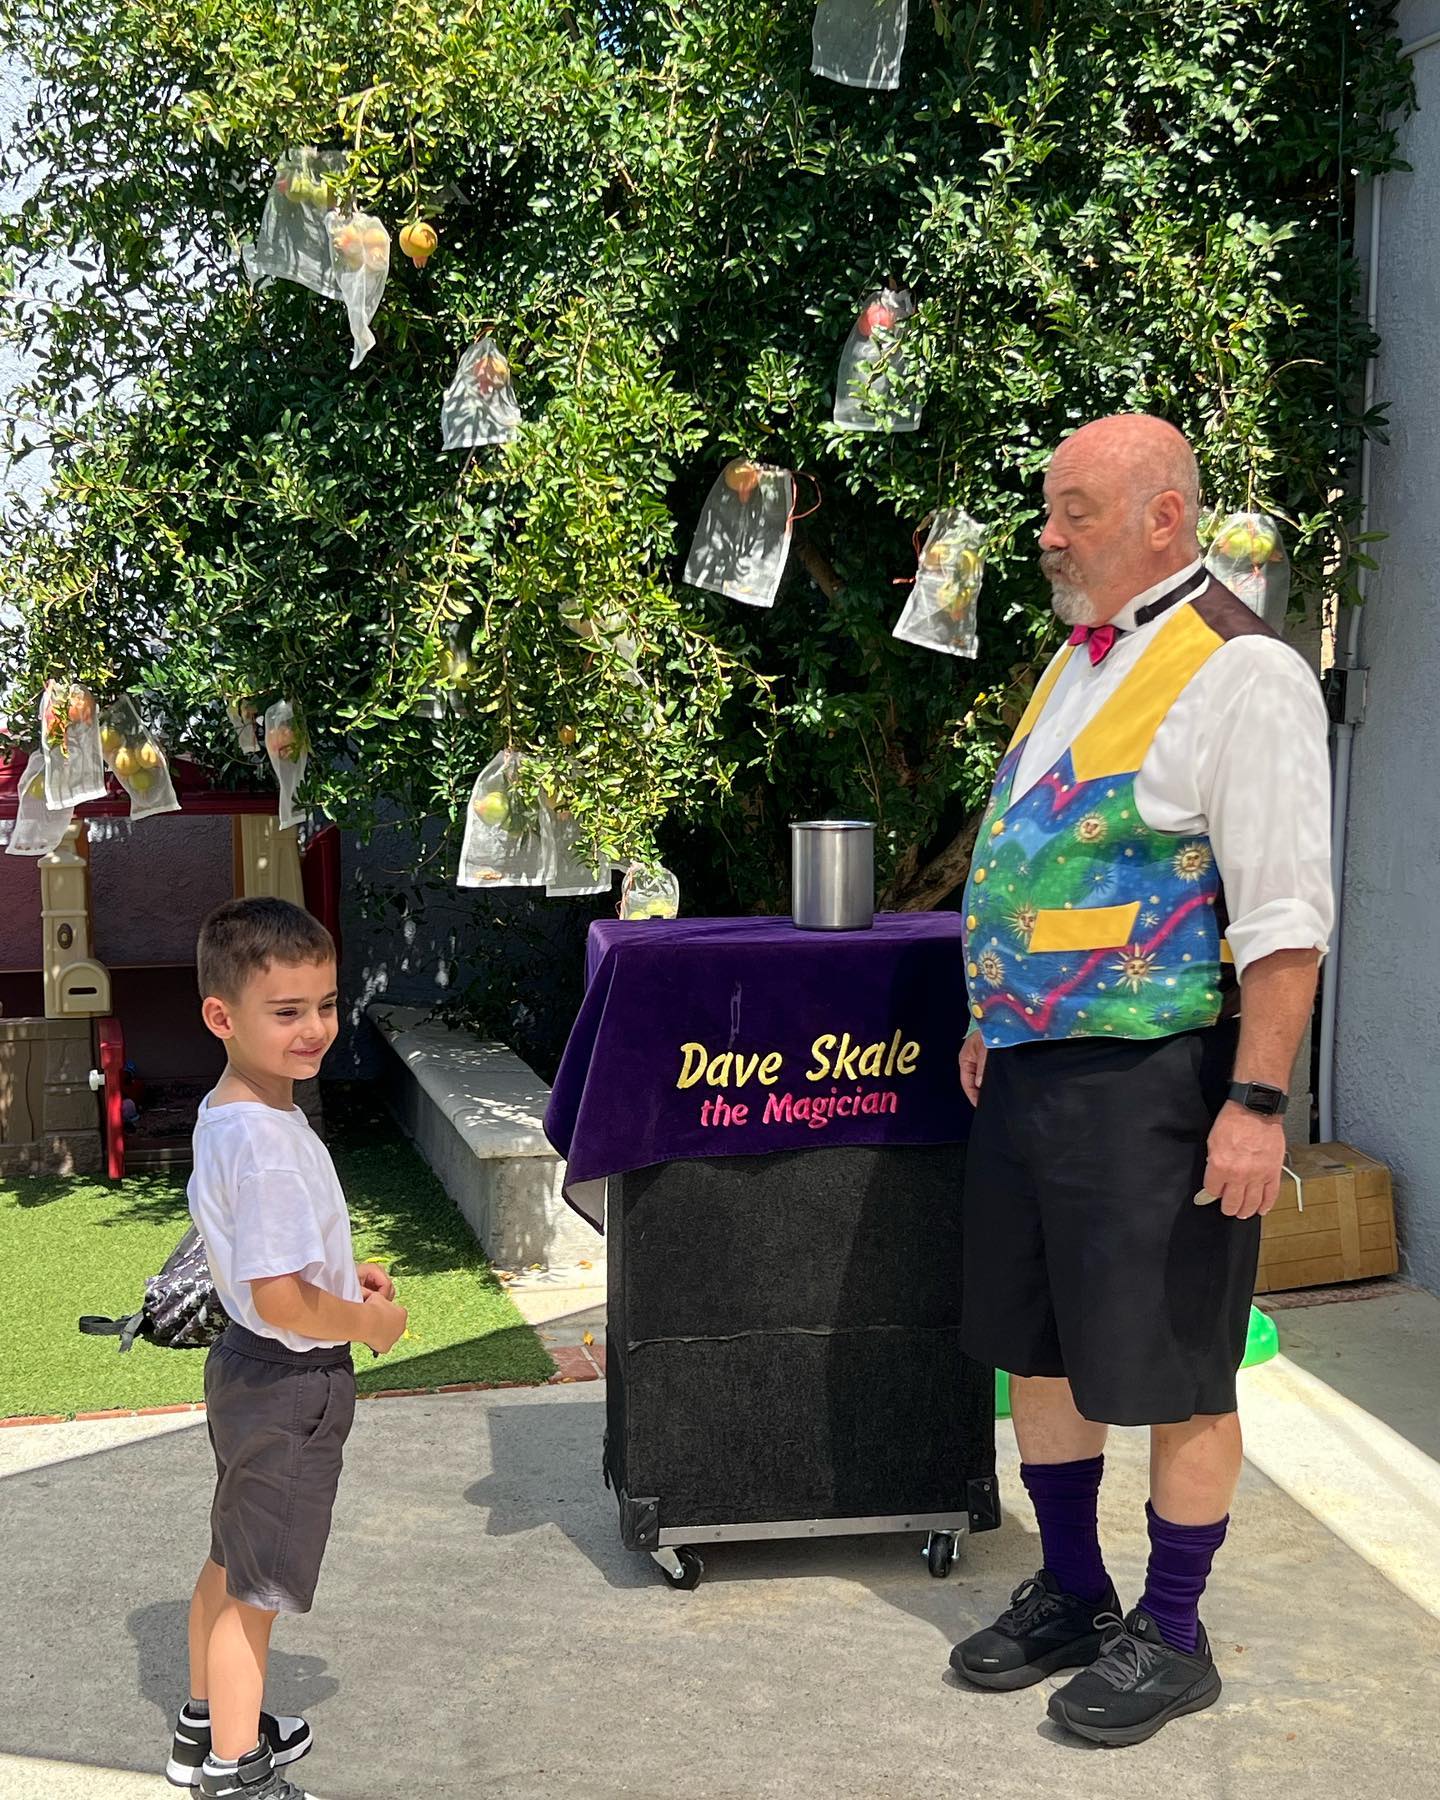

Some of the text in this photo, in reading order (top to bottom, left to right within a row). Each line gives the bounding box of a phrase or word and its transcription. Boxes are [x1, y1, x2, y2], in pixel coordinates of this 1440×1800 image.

[676, 1028, 920, 1089] Dave Skale
[700, 1086, 897, 1129] the Magician
